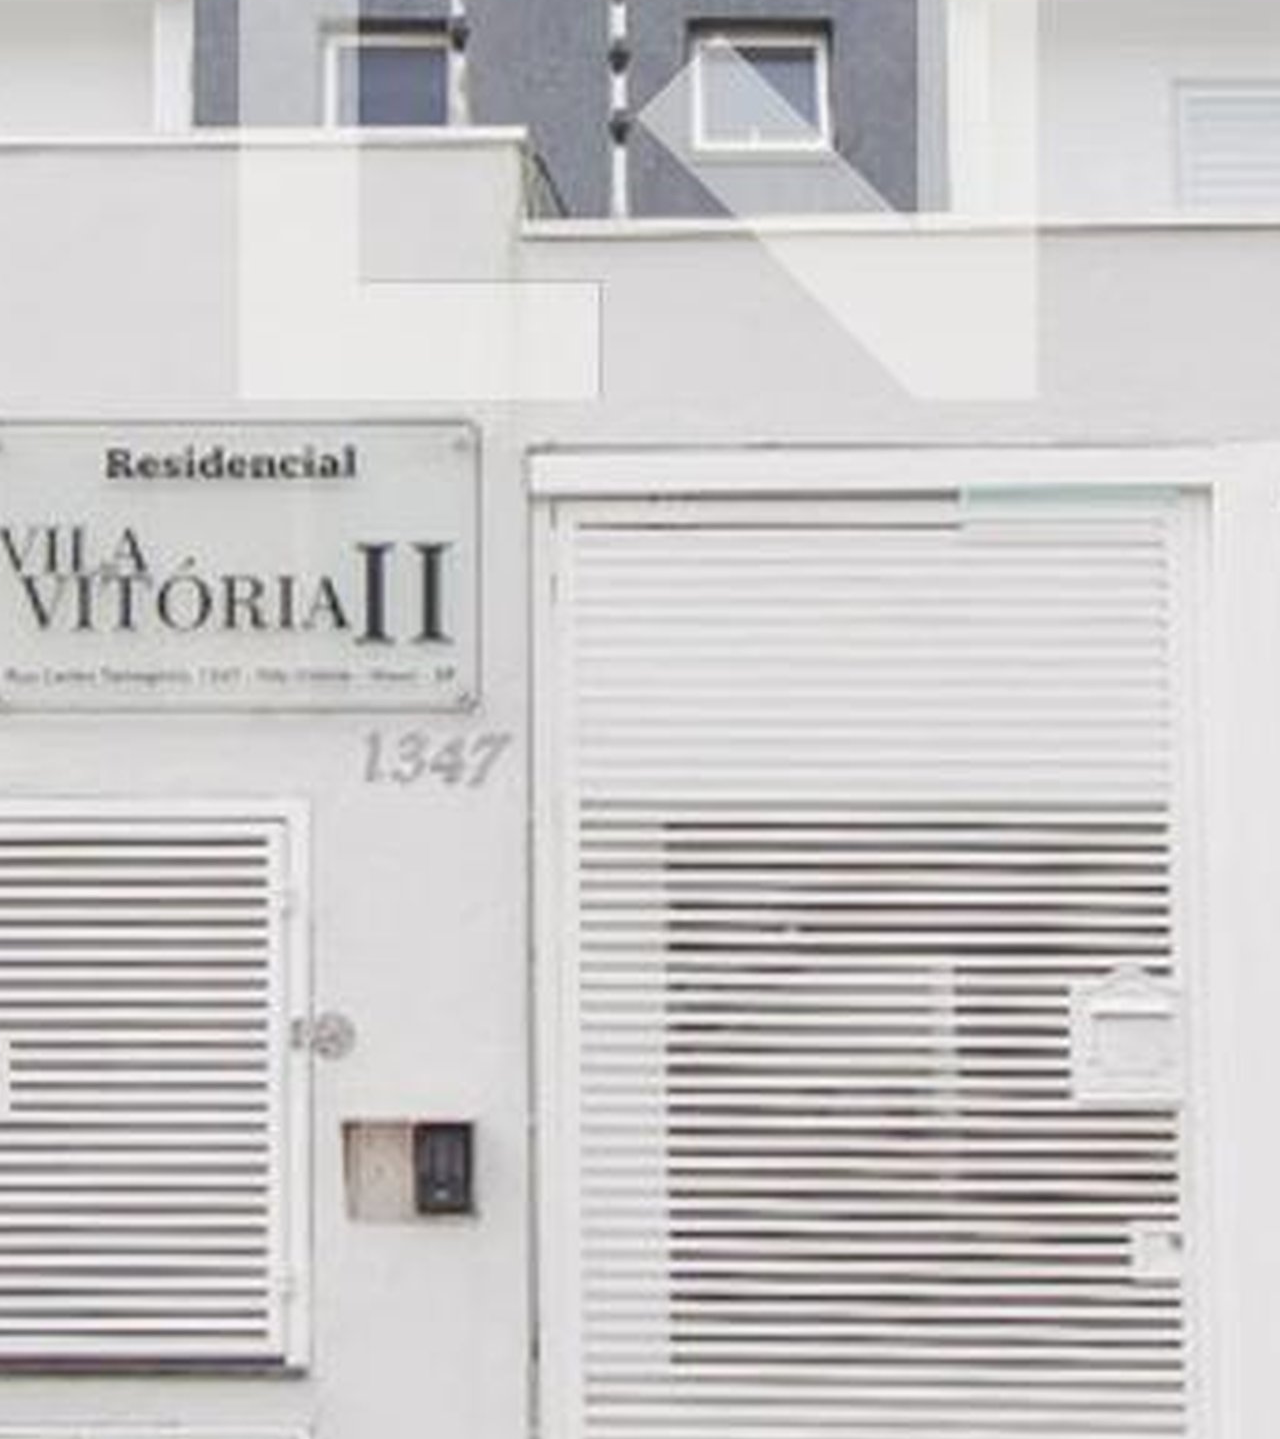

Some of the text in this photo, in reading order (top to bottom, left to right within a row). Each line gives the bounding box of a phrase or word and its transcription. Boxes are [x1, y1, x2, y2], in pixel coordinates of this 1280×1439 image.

[105, 445, 358, 480] Residencial
[21, 541, 455, 645] VITÓRIA II
[365, 729, 512, 789] 1347
